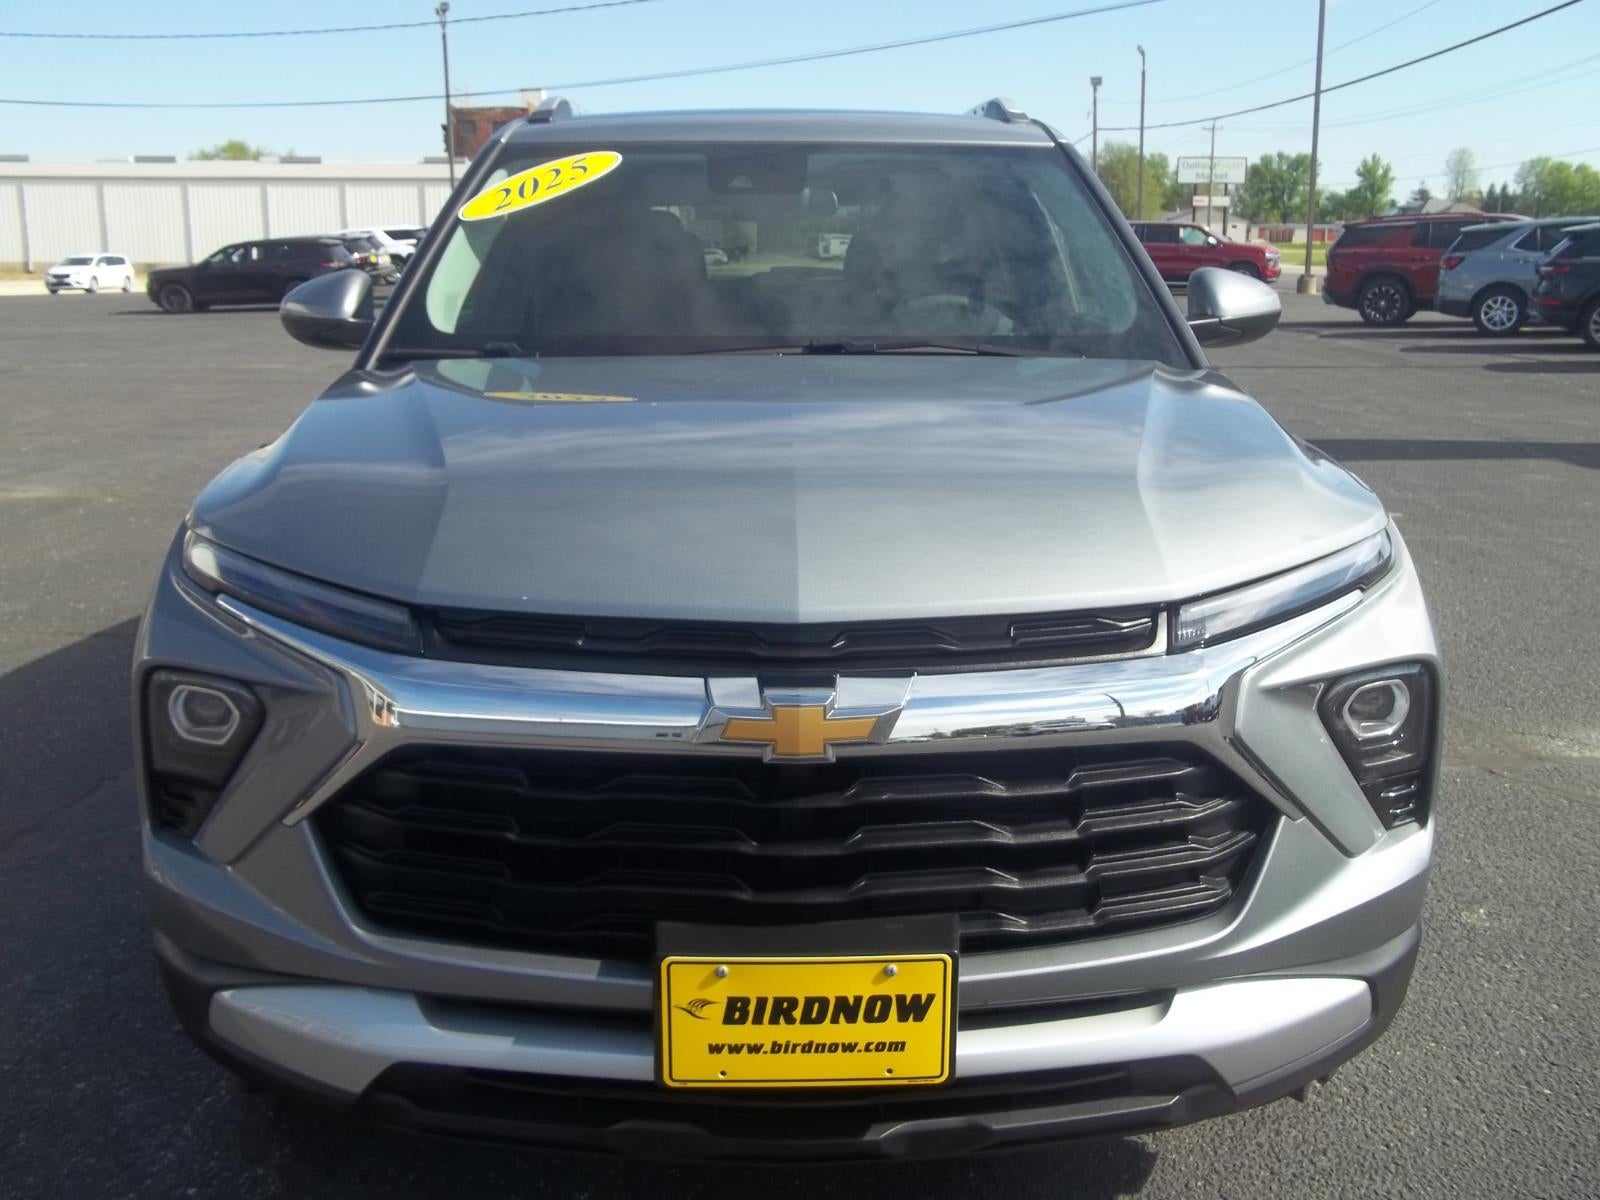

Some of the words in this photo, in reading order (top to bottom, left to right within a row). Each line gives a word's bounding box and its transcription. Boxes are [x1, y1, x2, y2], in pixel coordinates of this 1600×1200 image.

[495, 157, 588, 211] 2025
[1195, 171, 1228, 180] Maket
[721, 993, 936, 1026] BIRDNOW
[707, 1039, 907, 1056] www.birdnow.com
